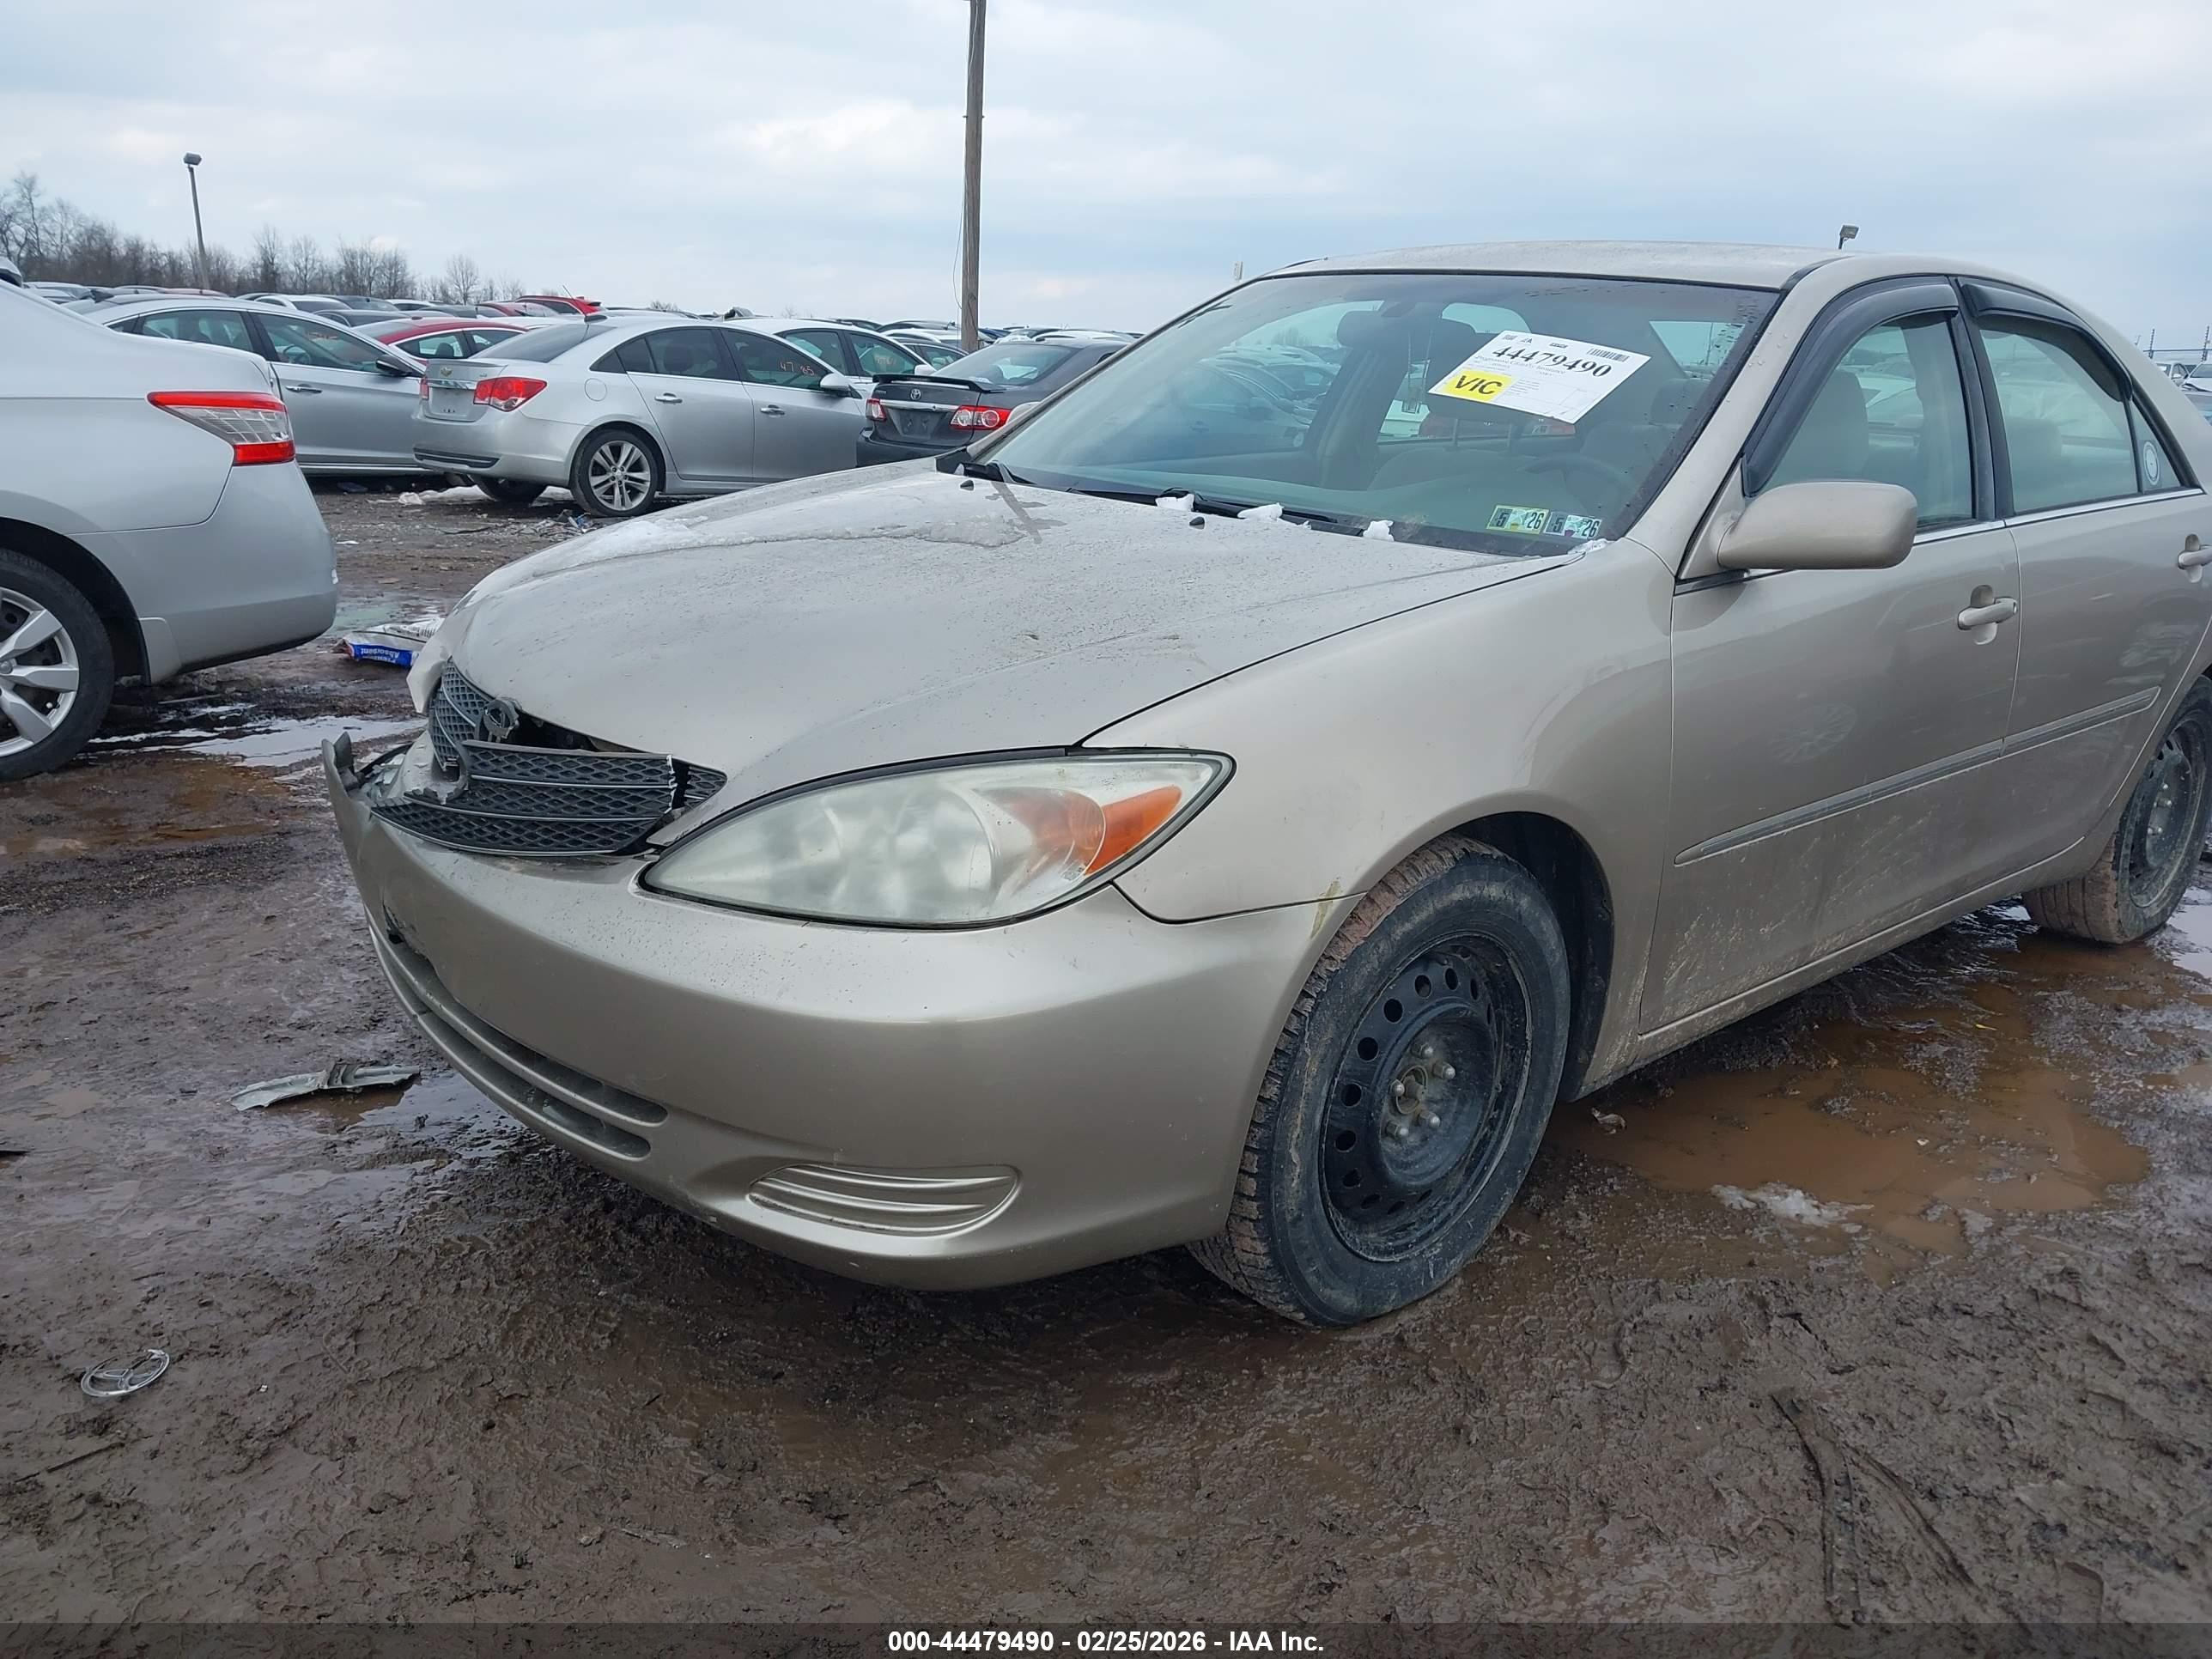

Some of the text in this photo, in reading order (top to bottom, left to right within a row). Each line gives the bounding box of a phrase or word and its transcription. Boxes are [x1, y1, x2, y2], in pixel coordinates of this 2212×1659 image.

[1492, 345, 1613, 377] 44479490
[1455, 374, 1503, 396] VIC
[1496, 512, 1545, 530] 5 26
[1553, 517, 1600, 538] 5 26
